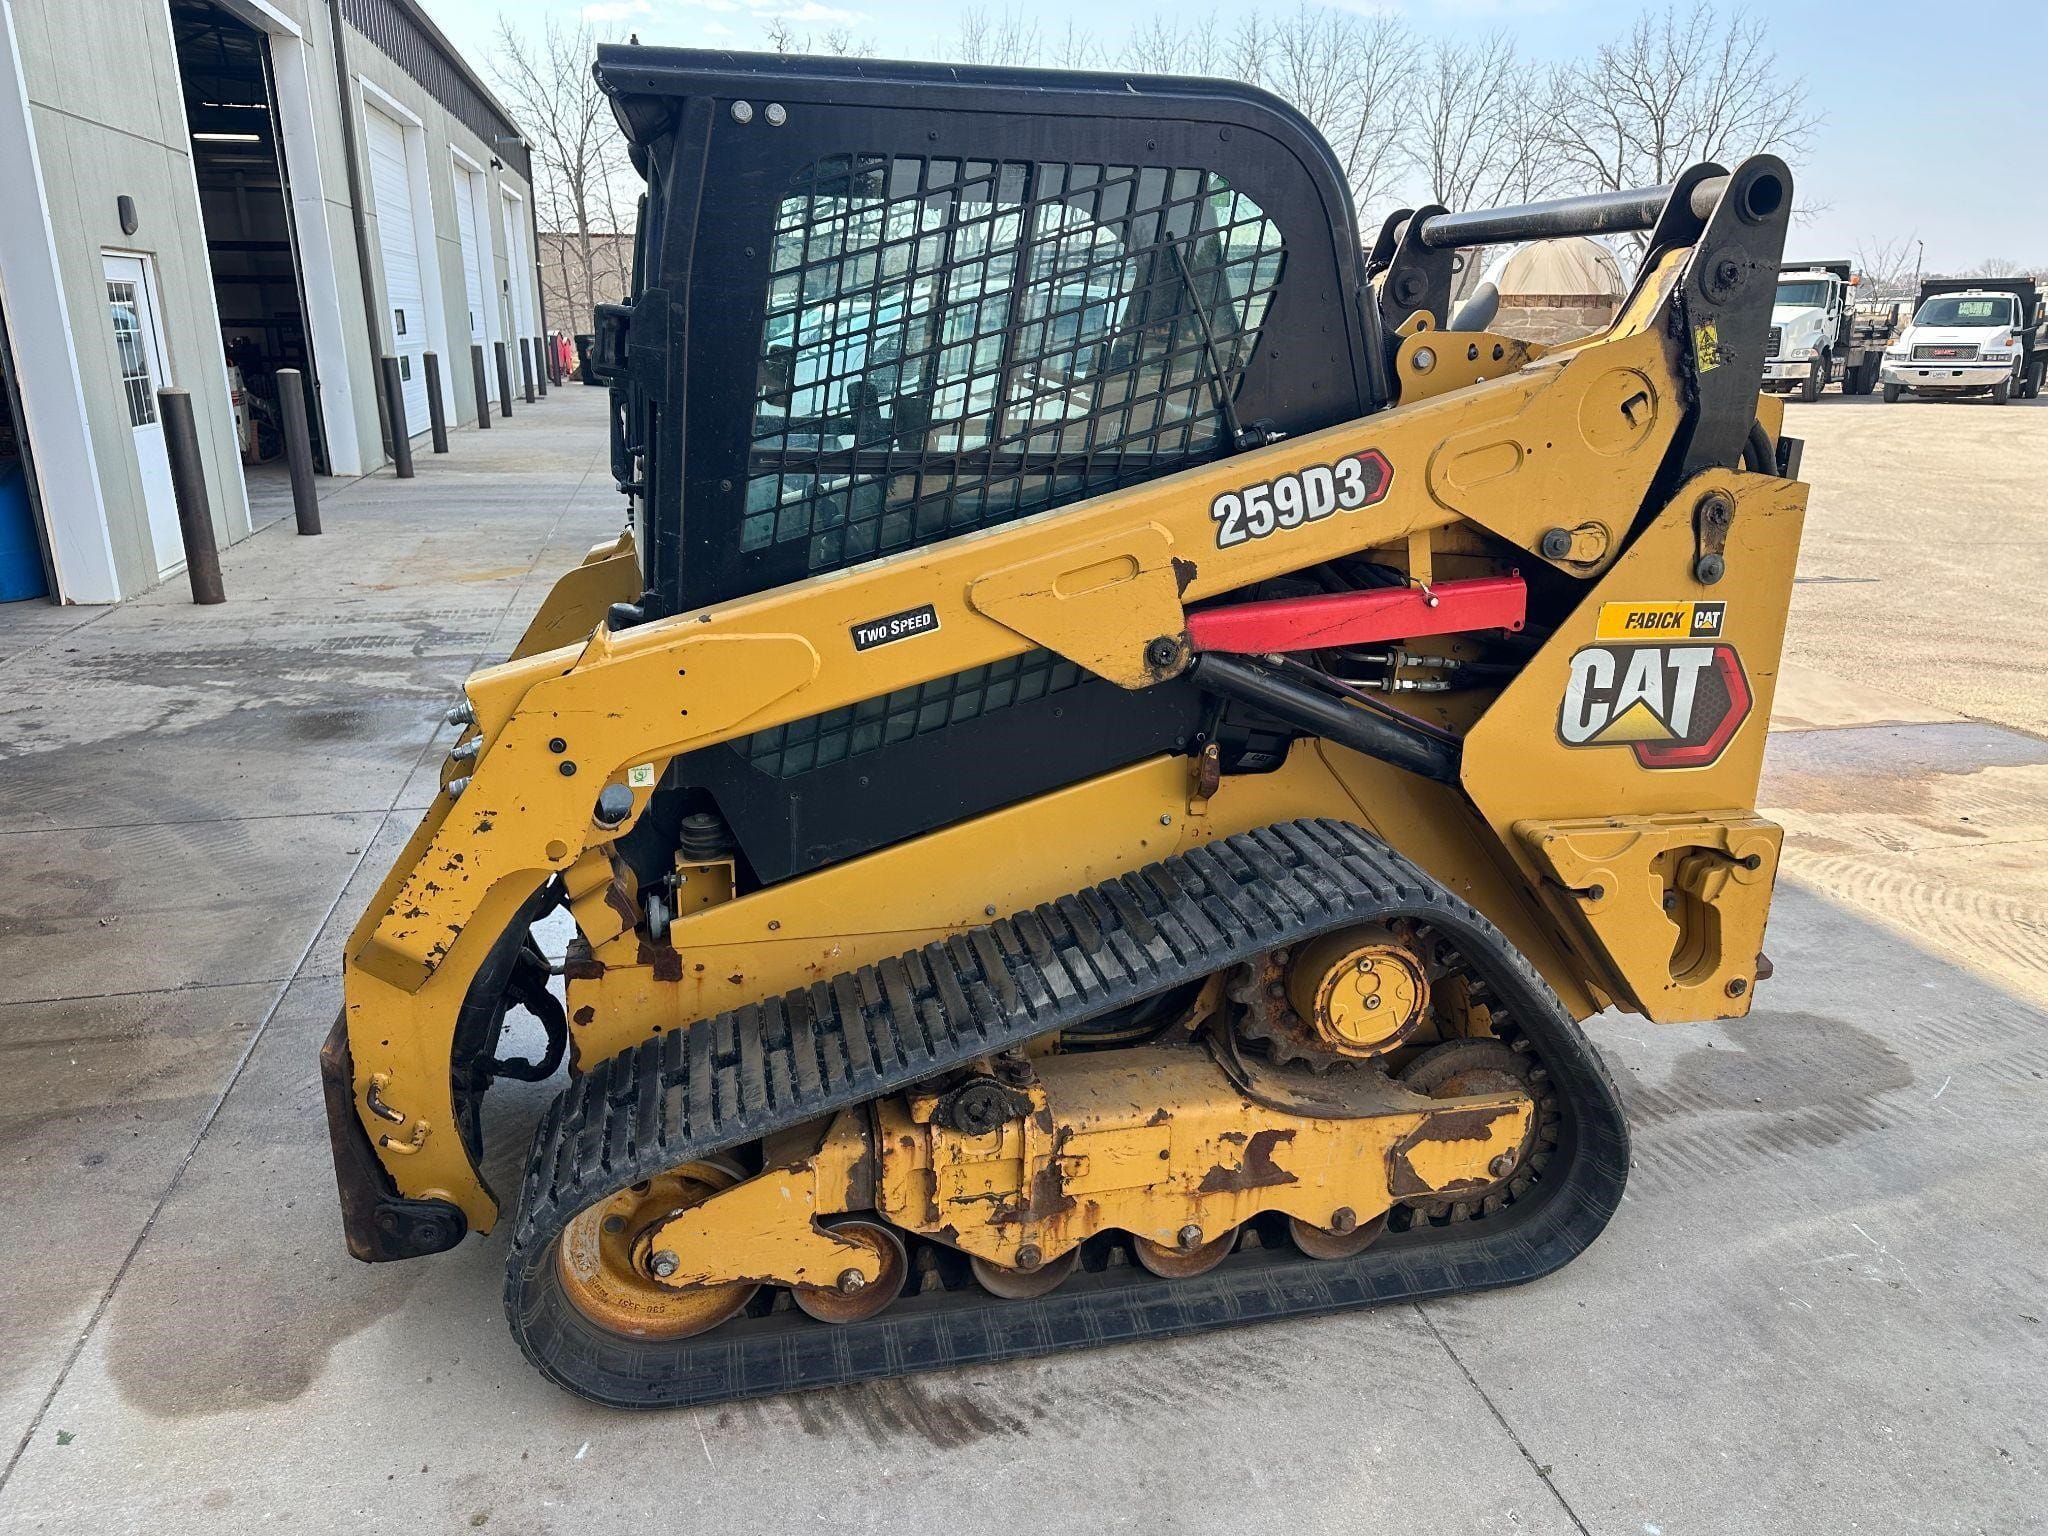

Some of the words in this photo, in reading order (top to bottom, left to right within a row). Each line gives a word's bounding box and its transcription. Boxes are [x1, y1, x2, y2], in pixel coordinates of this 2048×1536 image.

[1213, 457, 1366, 546] 259D3
[857, 625, 887, 644] TWO
[890, 613, 931, 635] SPEED
[1624, 611, 1687, 629] FABICK
[1694, 611, 1721, 629] CAT
[1561, 647, 1714, 743] CAT
